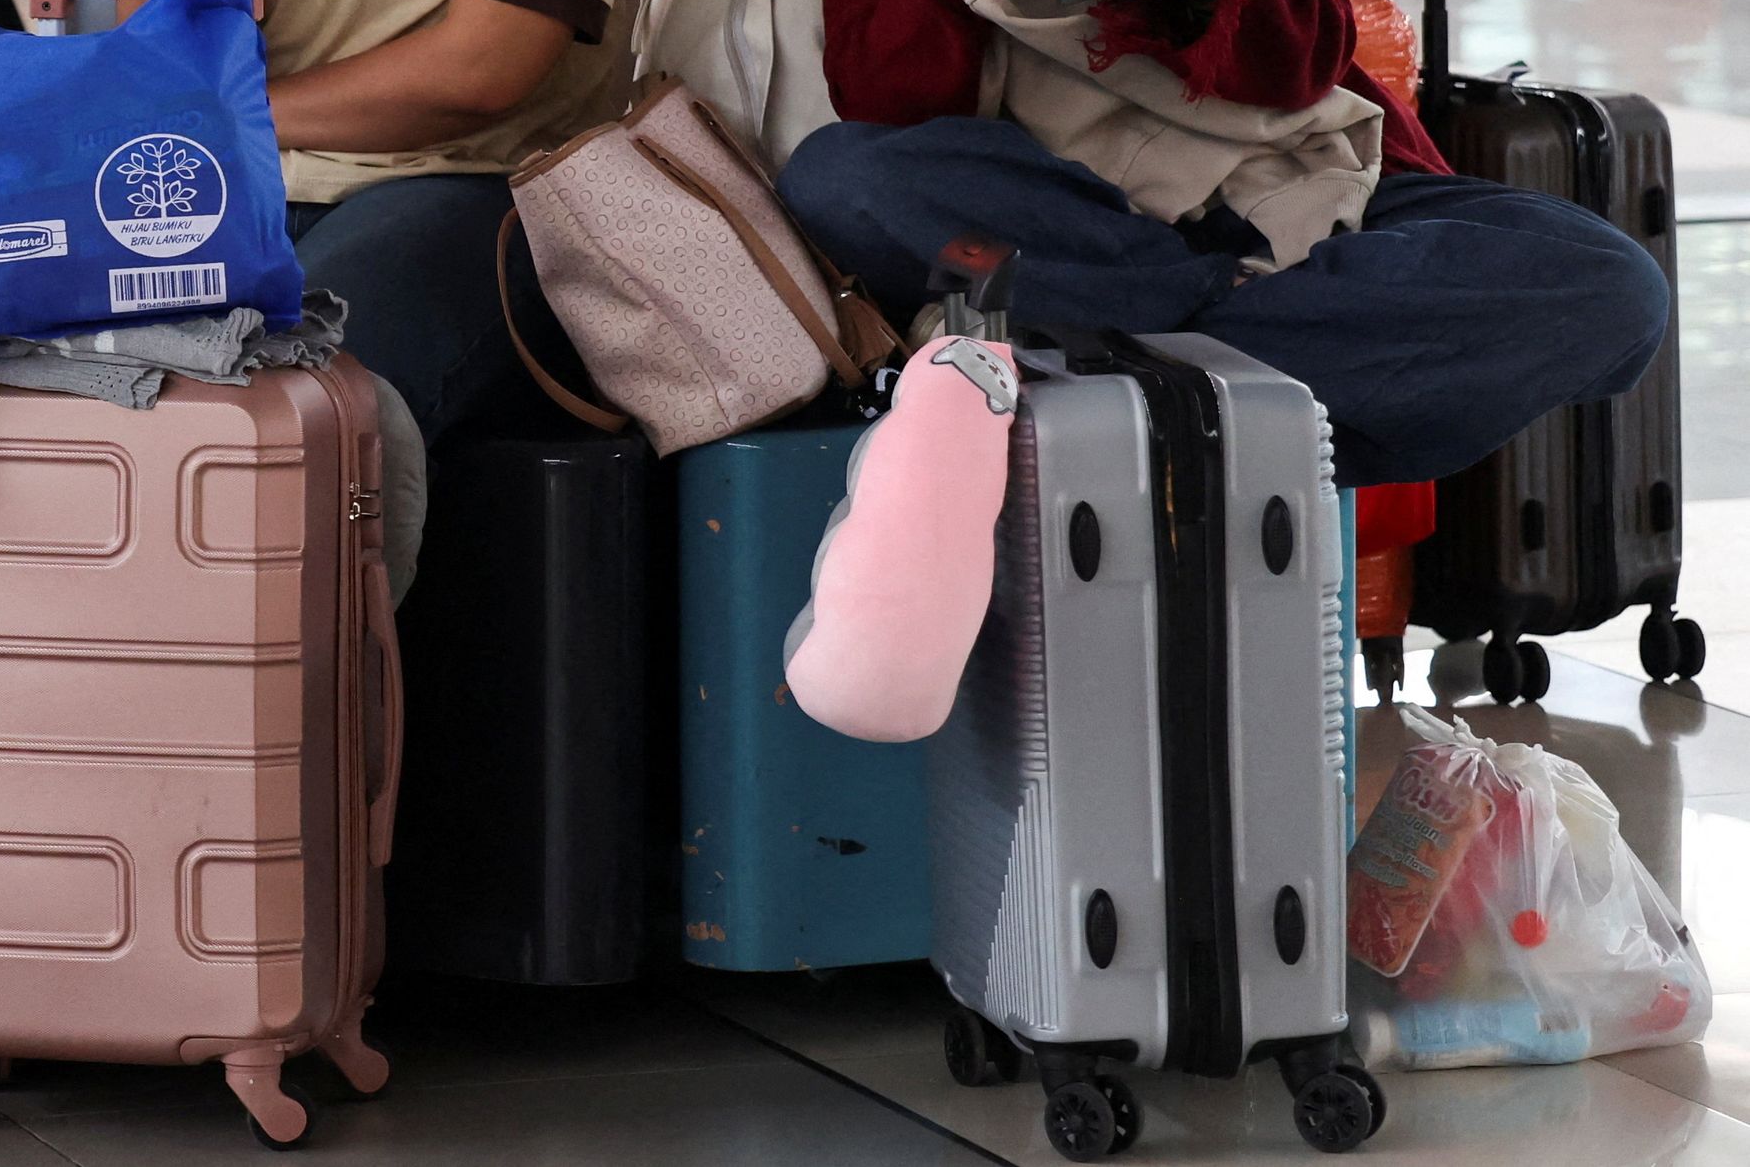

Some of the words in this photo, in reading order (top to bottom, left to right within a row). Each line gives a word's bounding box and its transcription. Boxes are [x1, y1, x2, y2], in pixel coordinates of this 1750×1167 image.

[121, 223, 150, 234] HIJAU
[152, 220, 192, 231] BUMIKU
[130, 235, 154, 246] BIRU
[156, 233, 205, 245] LANGITKU
